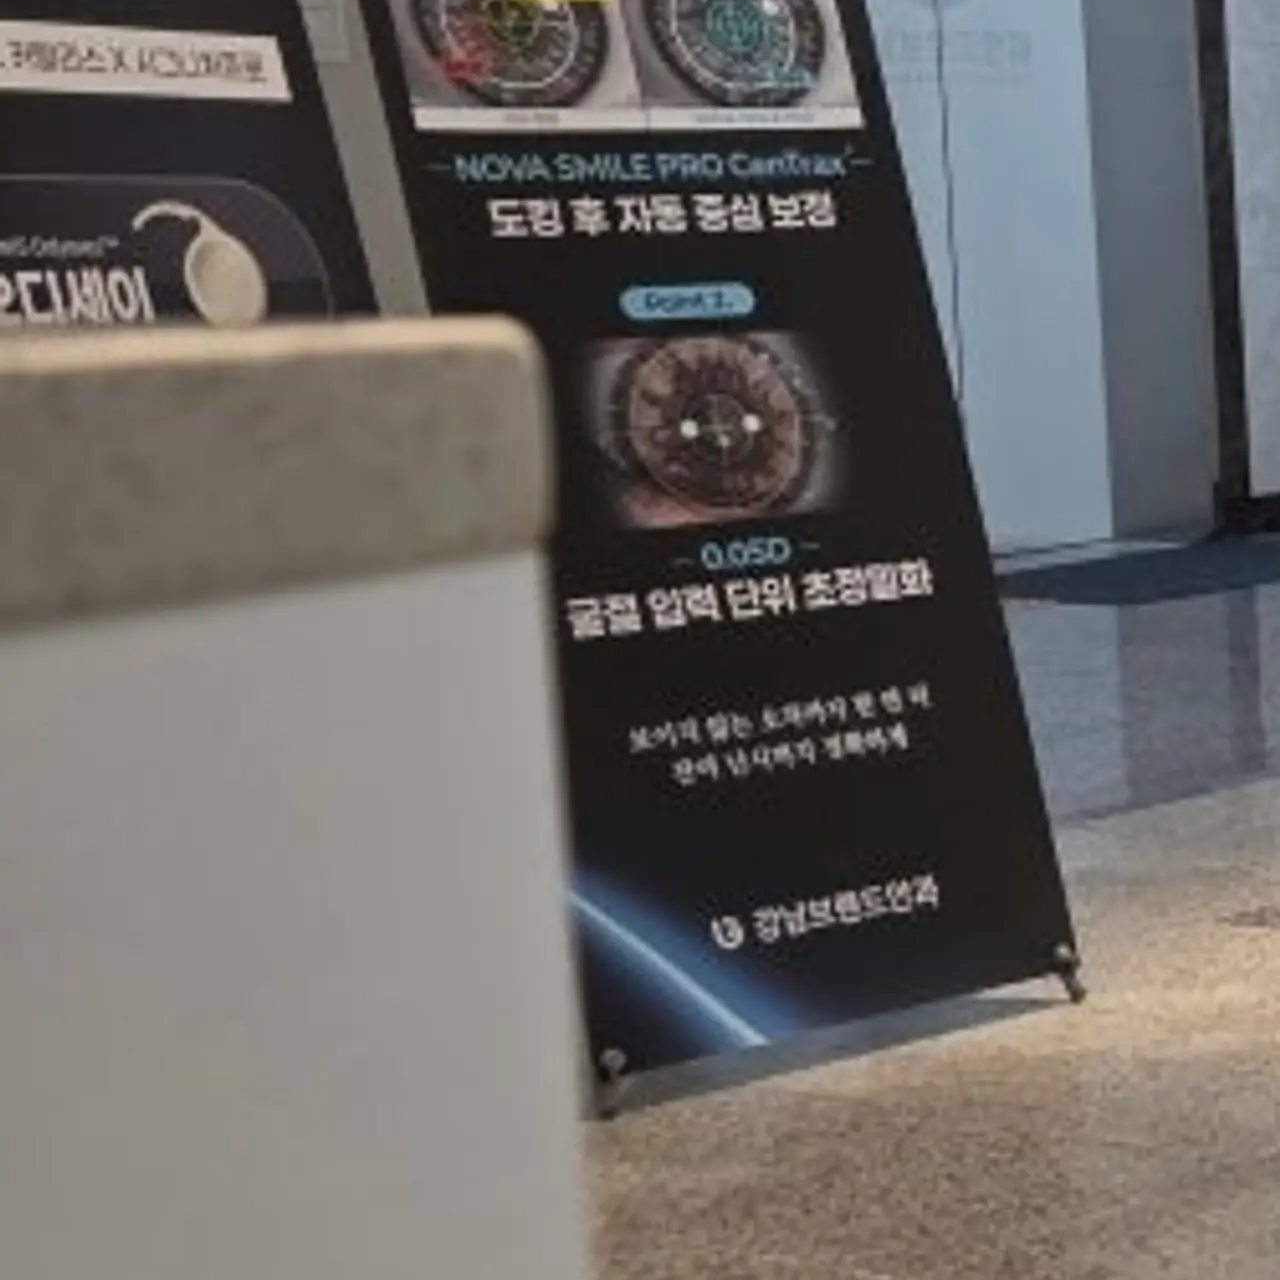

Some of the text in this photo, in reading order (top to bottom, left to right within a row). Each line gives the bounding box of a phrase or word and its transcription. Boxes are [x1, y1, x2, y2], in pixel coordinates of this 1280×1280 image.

[453, 152, 553, 183] NOVA
[556, 151, 652, 182] SMILE
[656, 151, 725, 181] PRO
[614, 193, 688, 235] 자동
[700, 537, 793, 569] 0.05D
[723, 574, 797, 621] 단위
